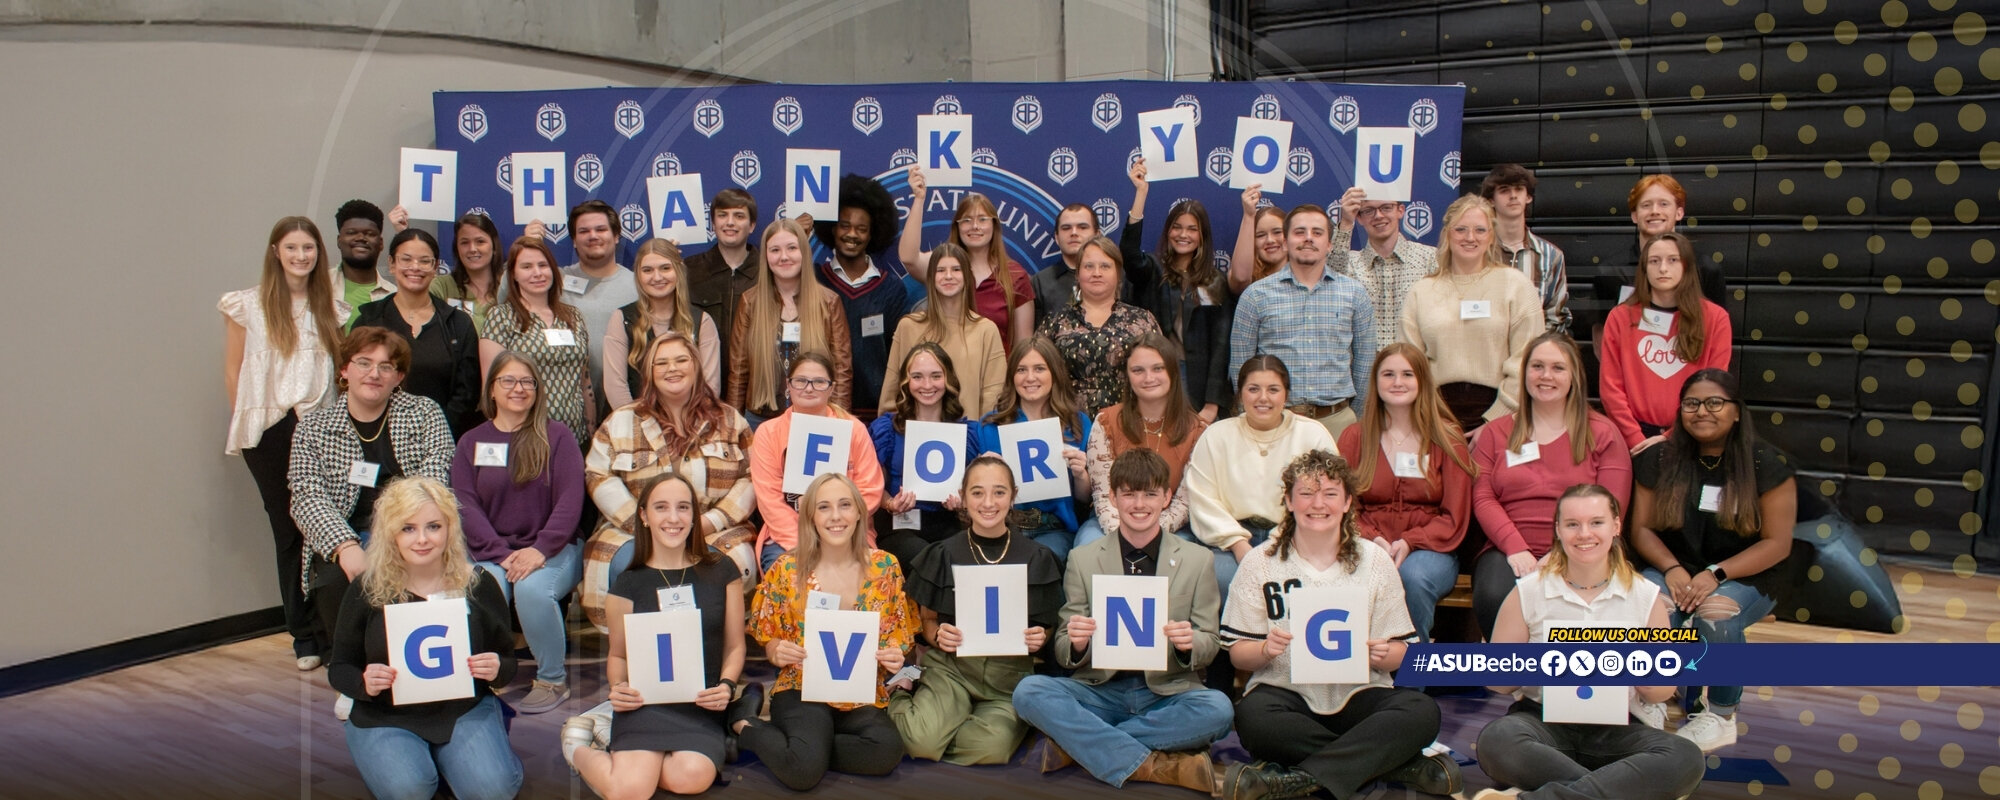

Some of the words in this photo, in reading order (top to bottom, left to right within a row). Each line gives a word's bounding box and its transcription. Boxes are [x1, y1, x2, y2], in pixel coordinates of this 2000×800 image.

[414, 163, 443, 202] T
[524, 169, 554, 206] H
[661, 189, 697, 229] A
[794, 165, 830, 203] N
[930, 131, 961, 169] K
[1151, 123, 1184, 162] Y
[1243, 136, 1279, 174] O
[1369, 144, 1403, 184] U
[997, 200, 1063, 260] UNIV
[803, 433, 833, 476] F
[915, 441, 955, 483] O
[1017, 440, 1056, 482] R
[404, 625, 453, 679] G
[657, 633, 672, 682] I
[820, 631, 866, 681] V
[985, 586, 999, 634] I
[1106, 597, 1155, 647] N
[1306, 609, 1351, 661] G
